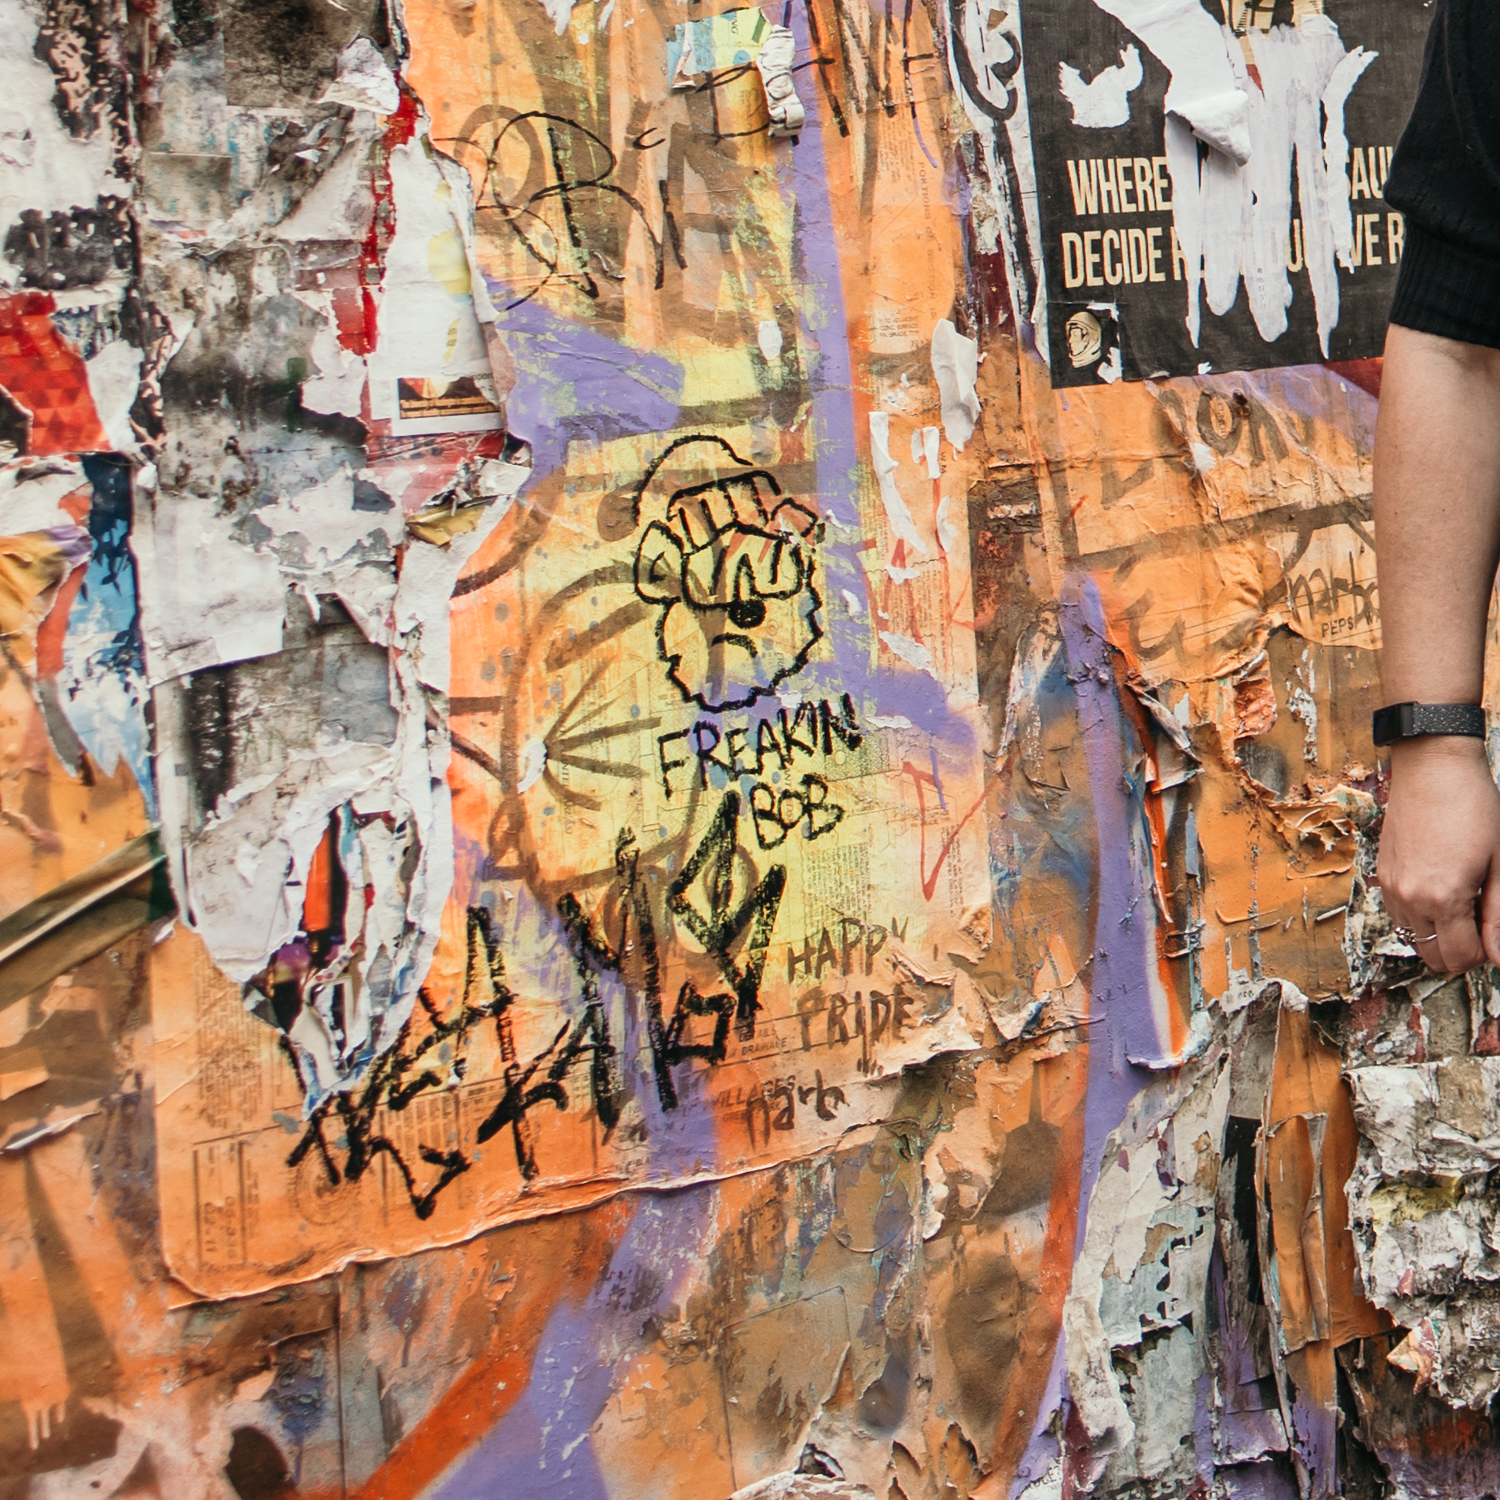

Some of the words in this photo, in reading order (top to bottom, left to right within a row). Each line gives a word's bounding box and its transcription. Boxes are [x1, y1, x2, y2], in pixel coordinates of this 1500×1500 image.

[1066, 154, 1173, 216] WHERE
[1061, 225, 1168, 290] DECIDE
[657, 692, 863, 800] FREAKIN
[750, 773, 844, 851] BOB
[787, 916, 910, 985] HAPPY
